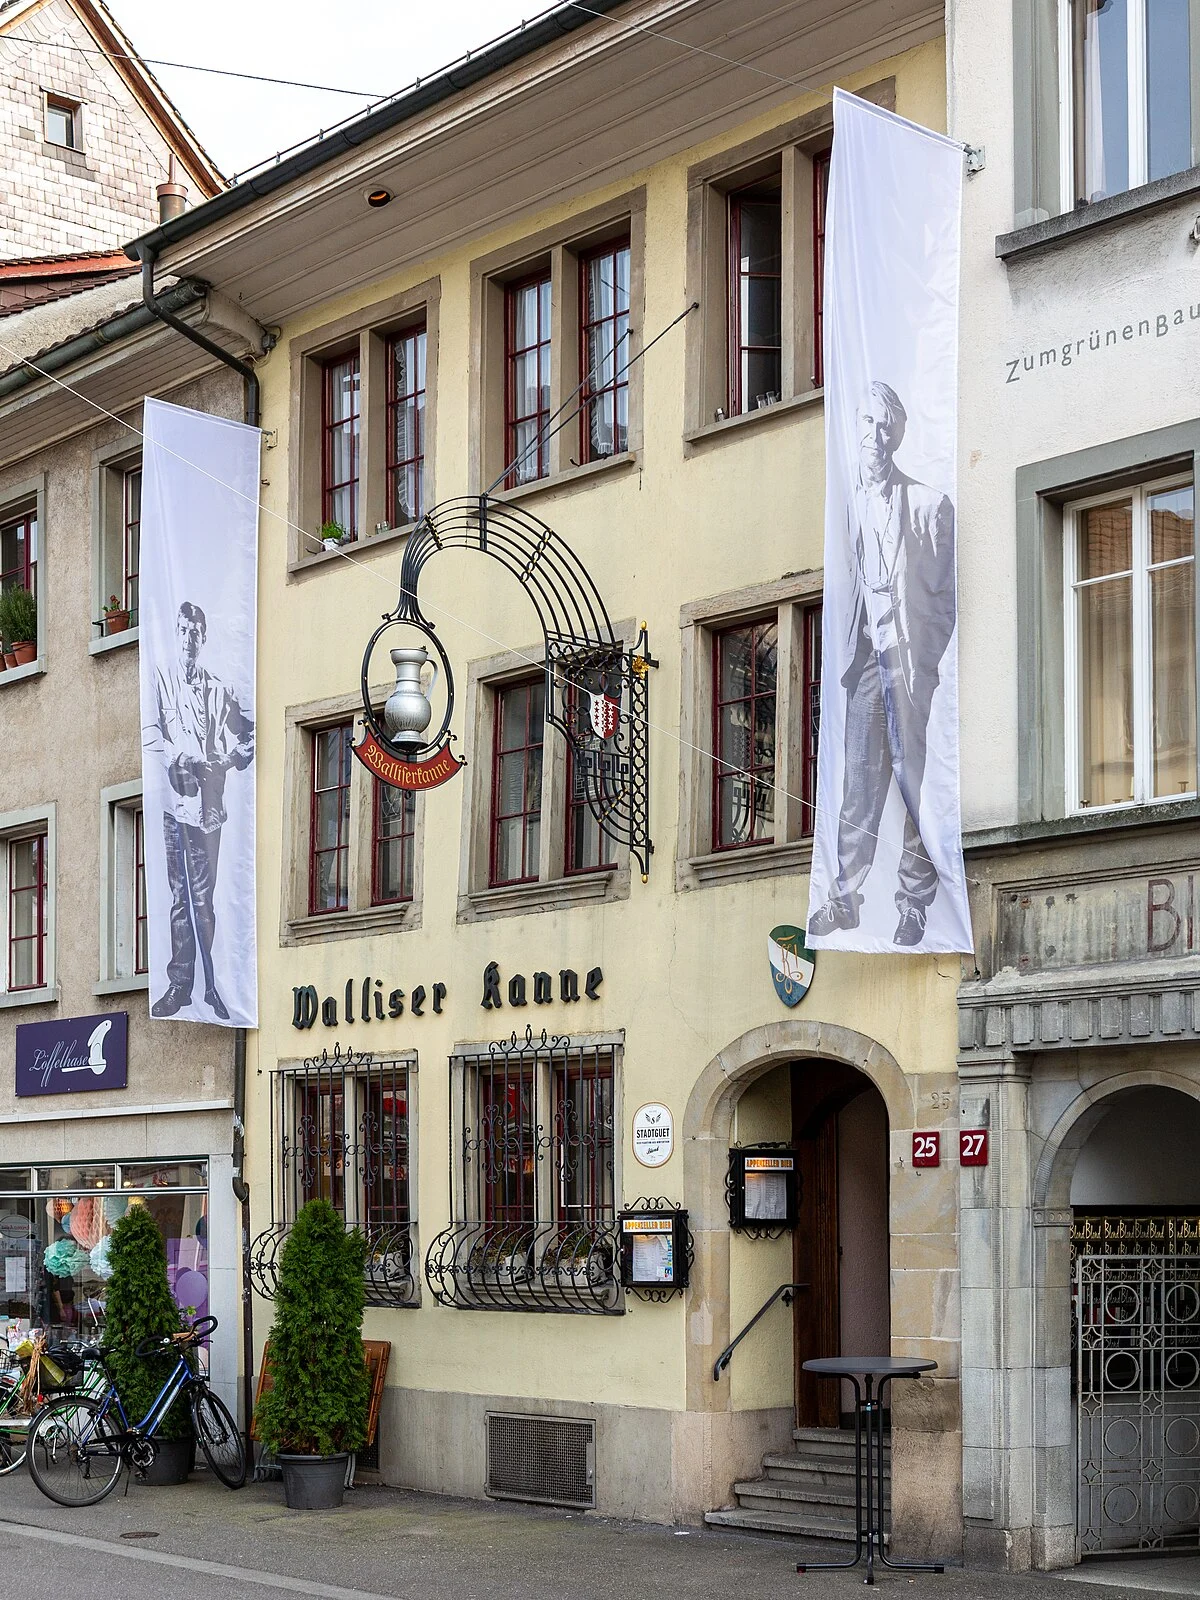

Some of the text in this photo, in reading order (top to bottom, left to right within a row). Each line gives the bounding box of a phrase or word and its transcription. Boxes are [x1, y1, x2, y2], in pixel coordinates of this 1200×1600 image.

[291, 960, 604, 1030] Walliser Kanne
[28, 1040, 89, 1088] Löffelhase
[931, 1091, 951, 1110] 25
[636, 1128, 670, 1139] STADTGUET
[914, 1136, 937, 1158] 25
[961, 1134, 985, 1156] 27
[746, 1159, 780, 1168] APPENZELLER
[624, 1220, 671, 1230] APPENZELLER BIER
